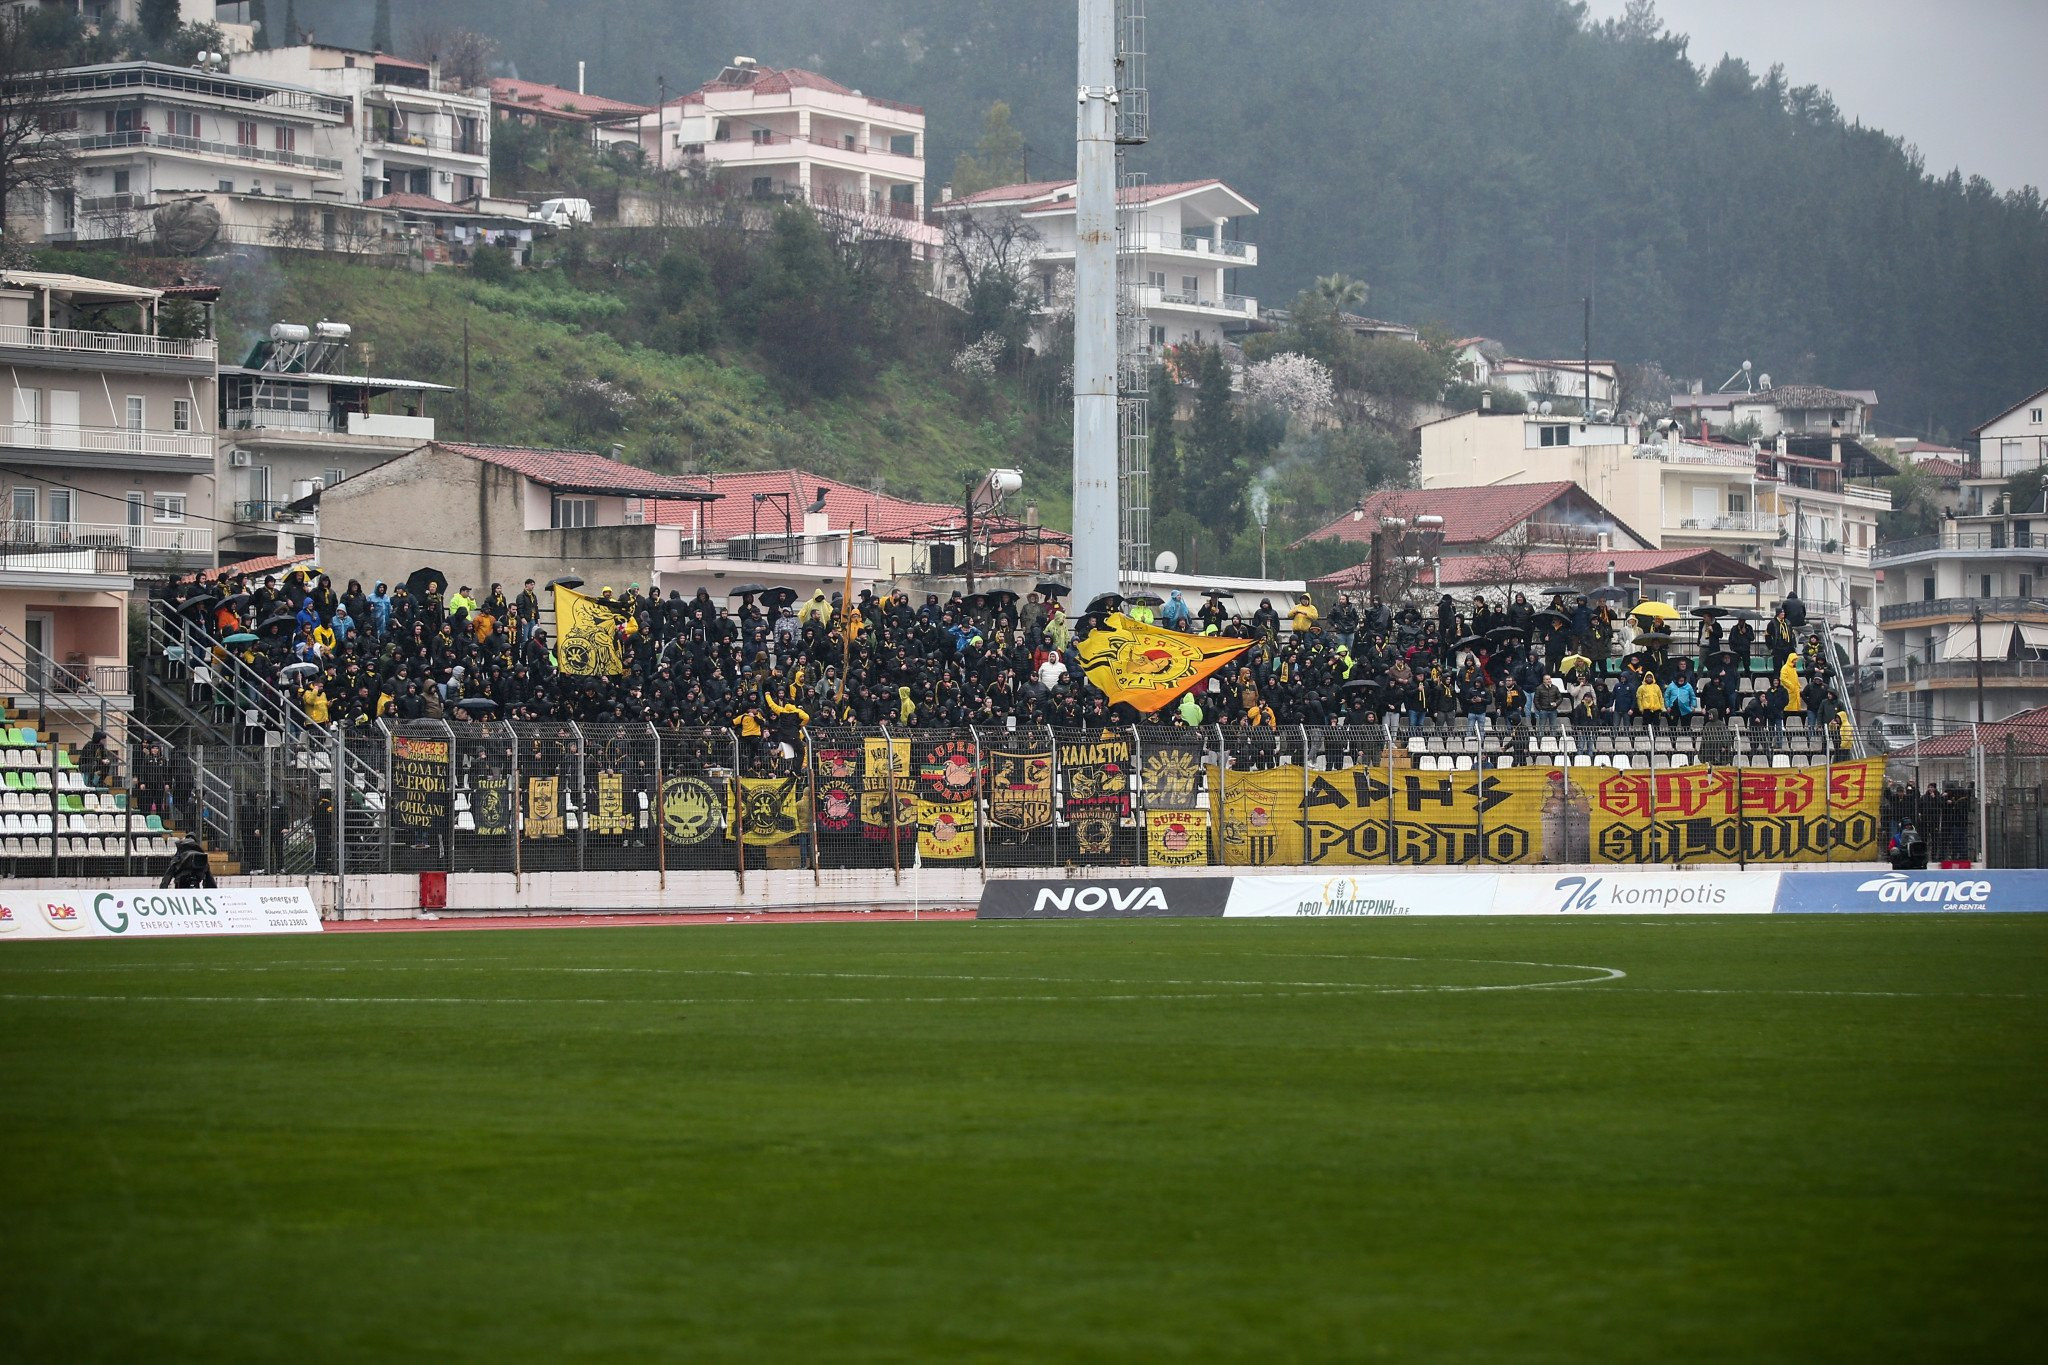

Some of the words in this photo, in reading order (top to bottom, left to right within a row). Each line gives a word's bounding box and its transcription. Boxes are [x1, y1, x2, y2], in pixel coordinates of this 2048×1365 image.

[408, 741, 436, 754] SUPER
[928, 741, 976, 765] SUPER
[1062, 742, 1129, 765] ΧΑΛΑΣΤΡΑ
[407, 763, 432, 776] ΟΛΑ
[863, 778, 917, 791] ΝΕΑΟΛΗ
[1599, 770, 1815, 818] SUPER
[1828, 764, 1868, 811] 3
[1153, 812, 1192, 827] SUPER
[1193, 817, 1202, 826] 3
[924, 838, 964, 856] SUPER
[1293, 818, 1530, 865] PORTO
[1034, 887, 1168, 911] NOVA
[1611, 884, 1726, 908] kompotis
[1878, 880, 1992, 903] avance
[47, 903, 77, 919] Dole
[133, 896, 218, 916] GONIAS
[1296, 901, 1322, 915] ΑΦΟΙ
[1326, 899, 1394, 915] ΑΙΚΑΤΕΡΙΝΗ
[140, 921, 173, 930] ENERGY
[184, 920, 223, 929] SYSTEMS
